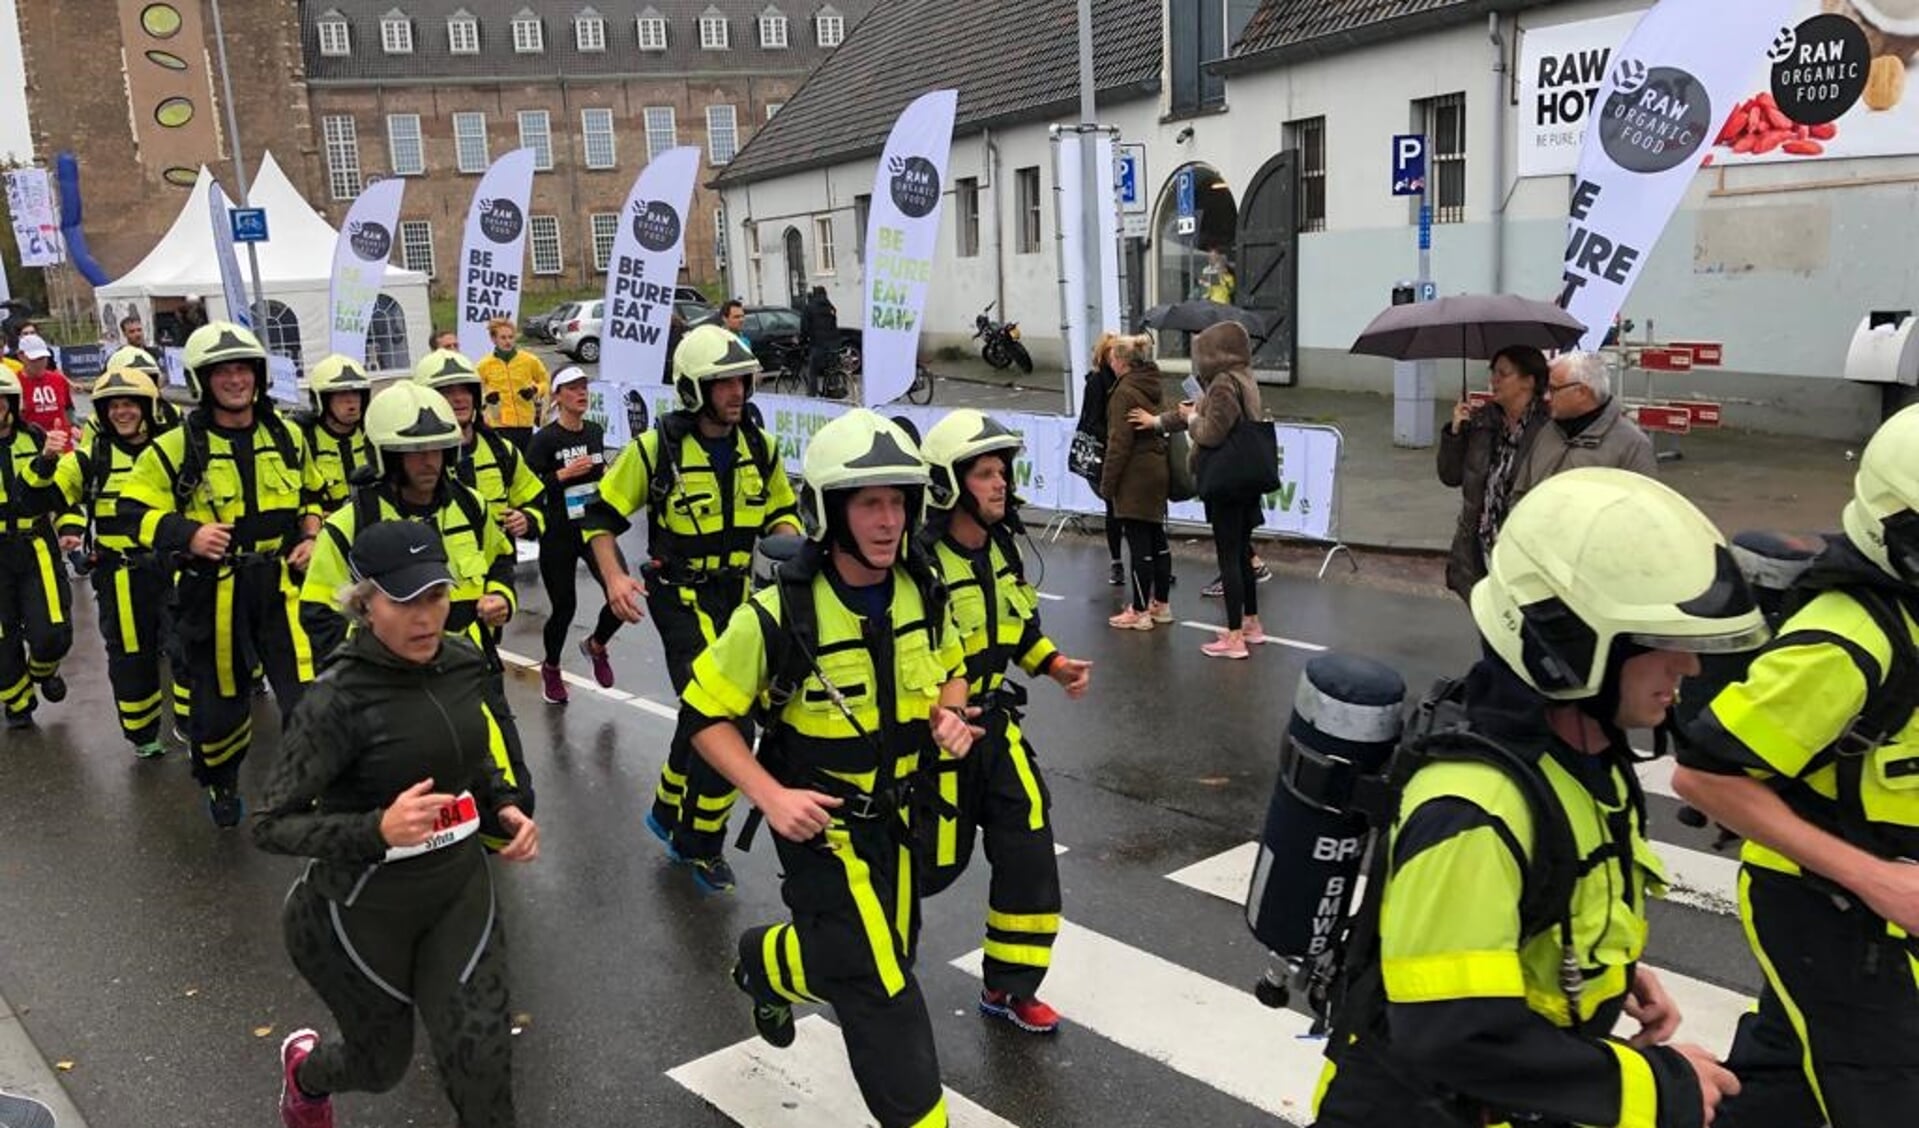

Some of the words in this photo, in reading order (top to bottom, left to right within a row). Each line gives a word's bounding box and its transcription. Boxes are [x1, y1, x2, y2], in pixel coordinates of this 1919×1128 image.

[1800, 39, 1845, 65] RAW
[1538, 48, 1611, 88] RAW
[1781, 62, 1858, 86] ORGANIC
[1639, 88, 1689, 121] RAW
[1797, 83, 1839, 102] FOOD
[1615, 104, 1692, 145] ORGANIC
[1536, 134, 1547, 147] BE
[1621, 126, 1665, 154] FOOD
[1400, 138, 1421, 169] P
[906, 170, 929, 185] RAW
[1180, 175, 1189, 198] P
[1570, 180, 1602, 221] E
[493, 208, 513, 219] RAW
[648, 211, 670, 225] RAW
[878, 227, 904, 251] BE
[470, 249, 493, 269] BE
[618, 256, 645, 278] BE
[875, 255, 930, 281] PURE
[1565, 227, 1640, 286] URE
[468, 268, 518, 292] PURE
[615, 277, 672, 305] PURE
[873, 279, 909, 306] EAT
[467, 286, 502, 307] EAT
[466, 305, 512, 322] RAW
[613, 298, 653, 323] EAT
[872, 306, 917, 332] RAW
[610, 319, 661, 345] RAW
[33, 386, 57, 404] 40
[775, 410, 794, 432] BE
[775, 433, 801, 459] EAT
[433, 803, 462, 832] 84
